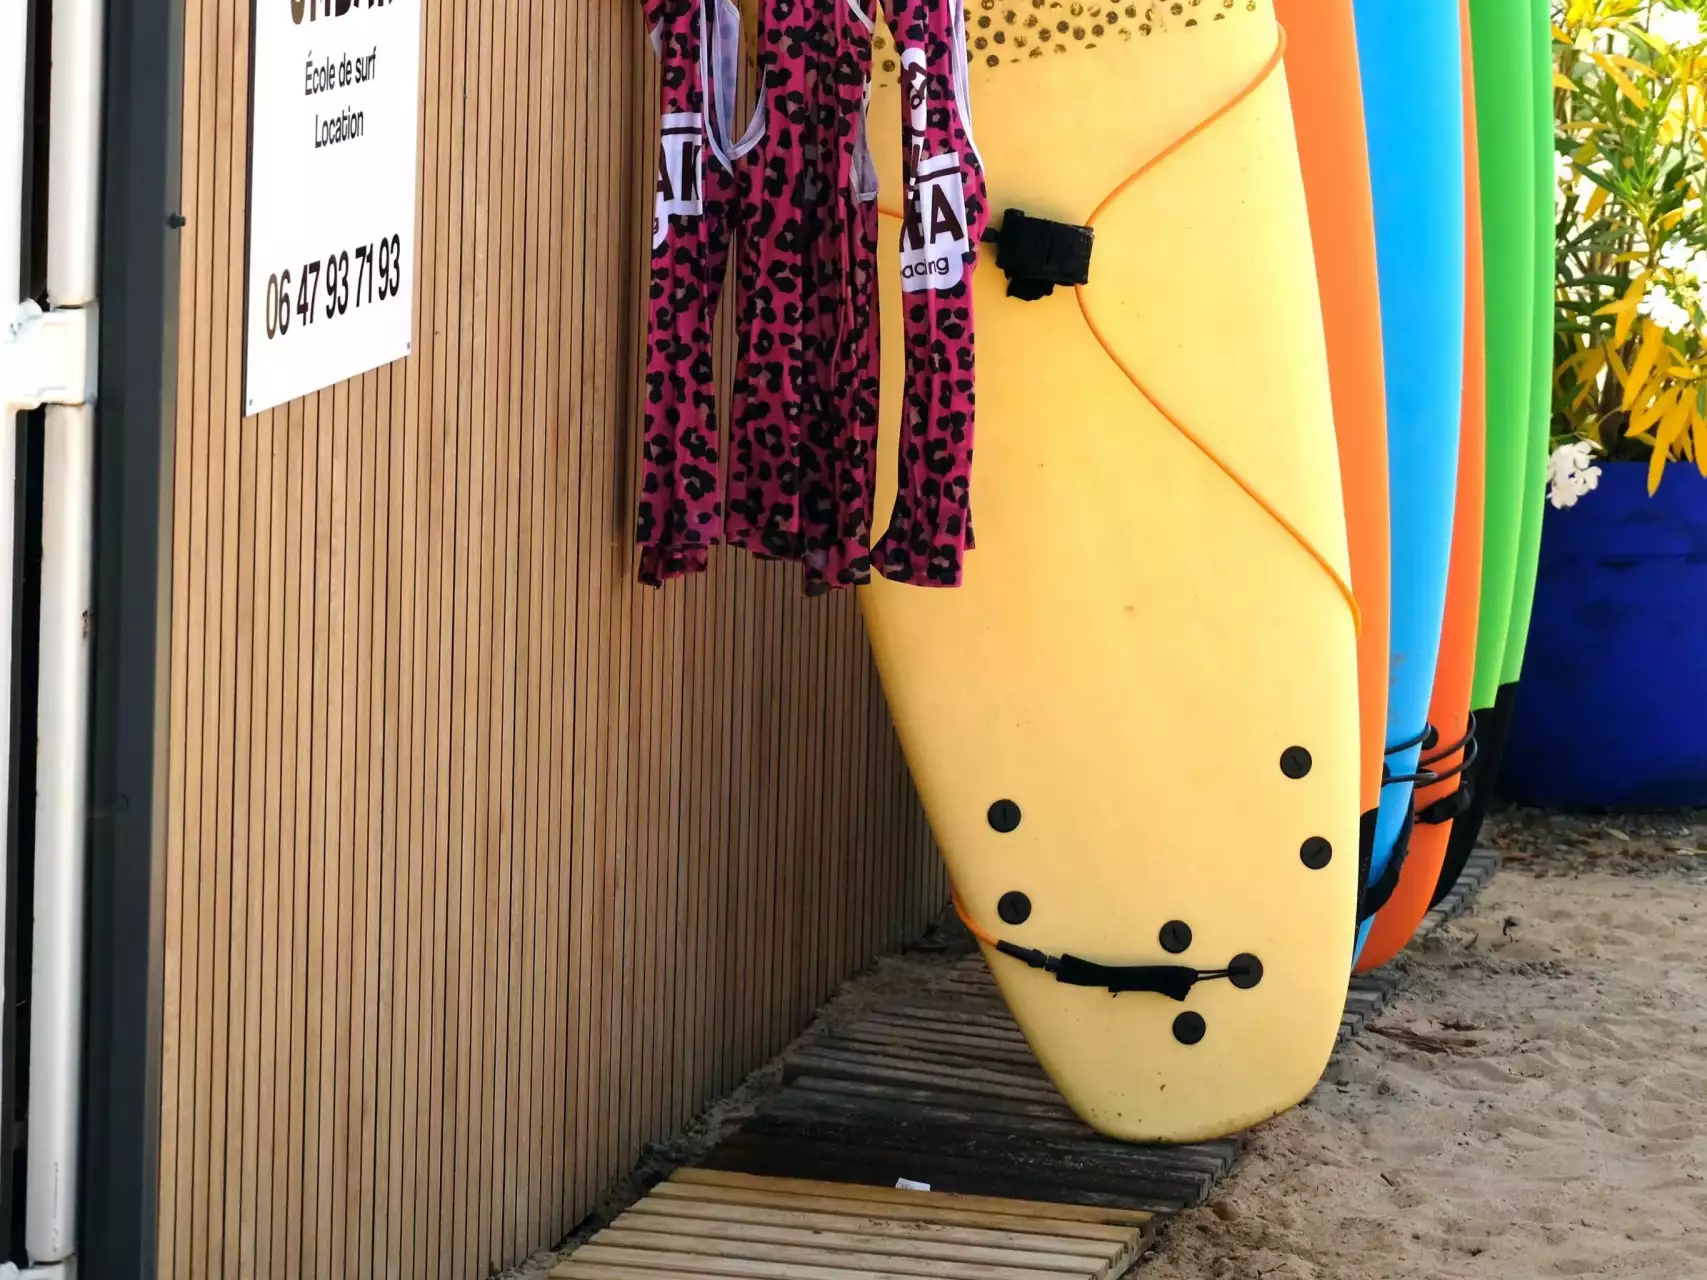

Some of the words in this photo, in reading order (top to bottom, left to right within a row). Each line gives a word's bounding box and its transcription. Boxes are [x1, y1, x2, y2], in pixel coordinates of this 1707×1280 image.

[305, 49, 335, 96] École
[339, 52, 352, 89] de
[355, 45, 377, 83] surf
[315, 106, 364, 149] Location
[266, 269, 291, 340] 06
[297, 260, 320, 326] 47
[326, 250, 349, 319] 93
